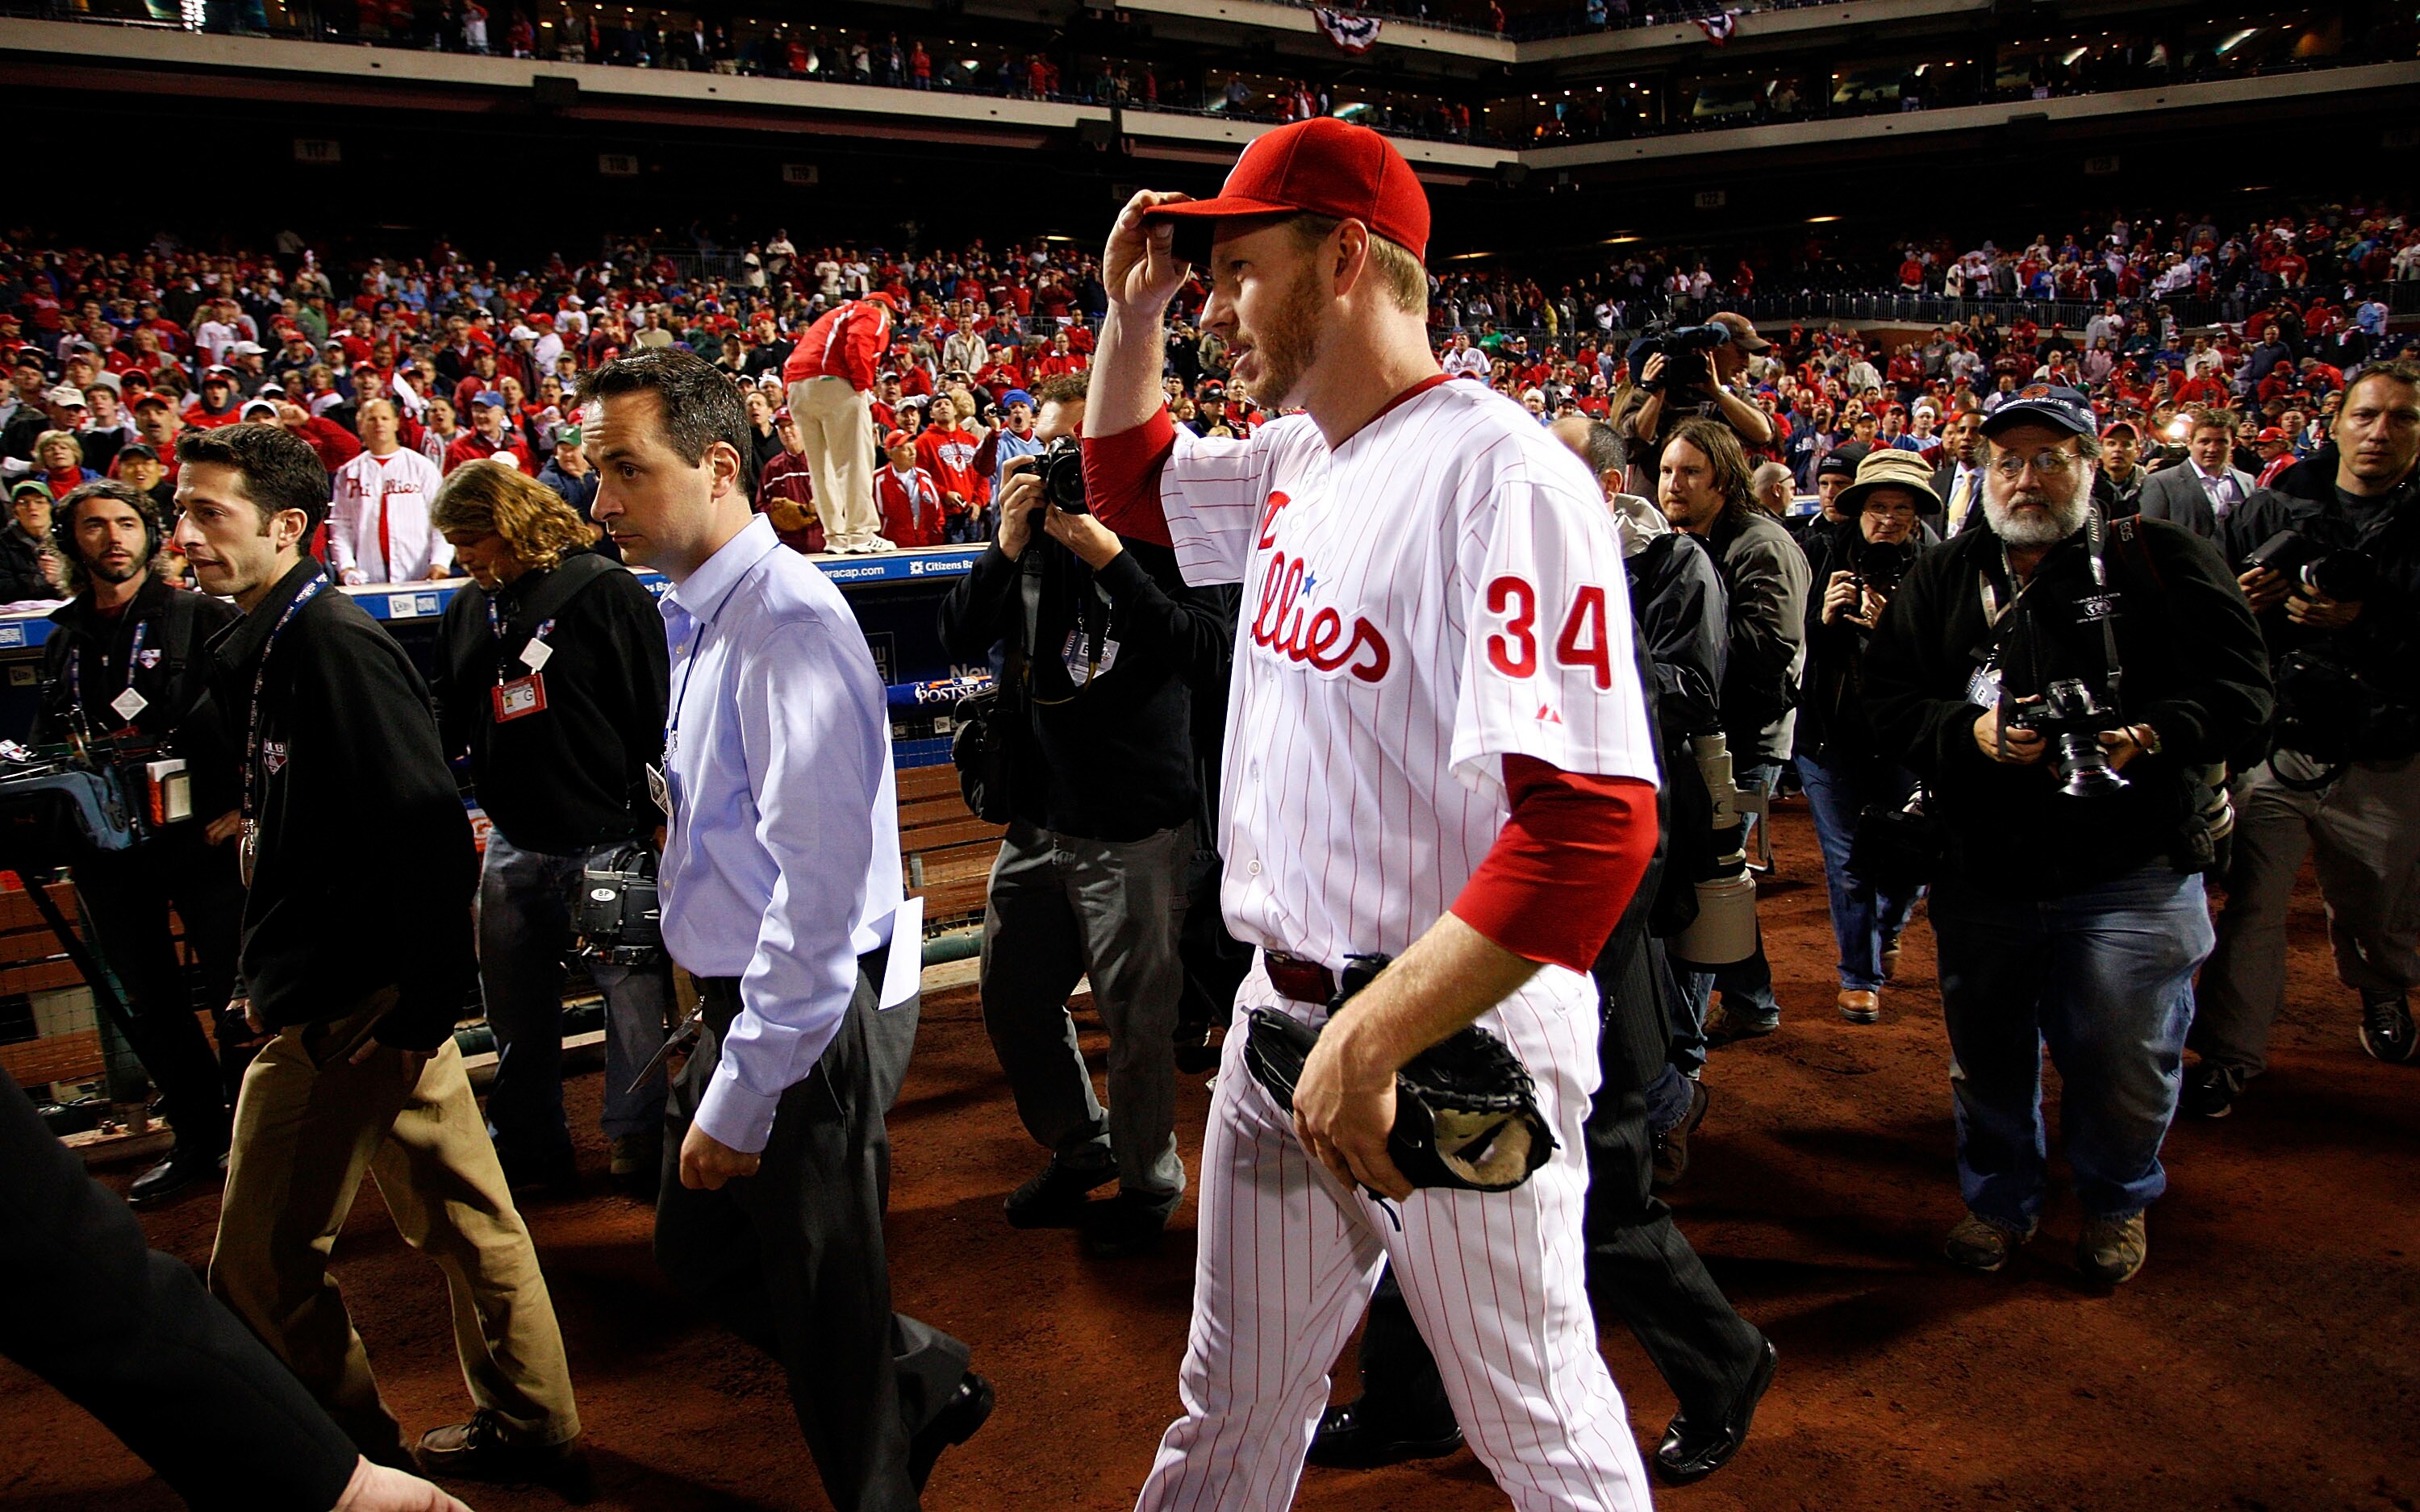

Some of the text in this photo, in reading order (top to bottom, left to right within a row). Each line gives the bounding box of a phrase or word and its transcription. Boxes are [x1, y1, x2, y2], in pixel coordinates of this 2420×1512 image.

[2088, 506, 2100, 543] Canon
[2118, 521, 2134, 542] EOS
[925, 561, 962, 572] Citizens
[1487, 576, 1612, 690] 34
[524, 689, 533, 702] G
